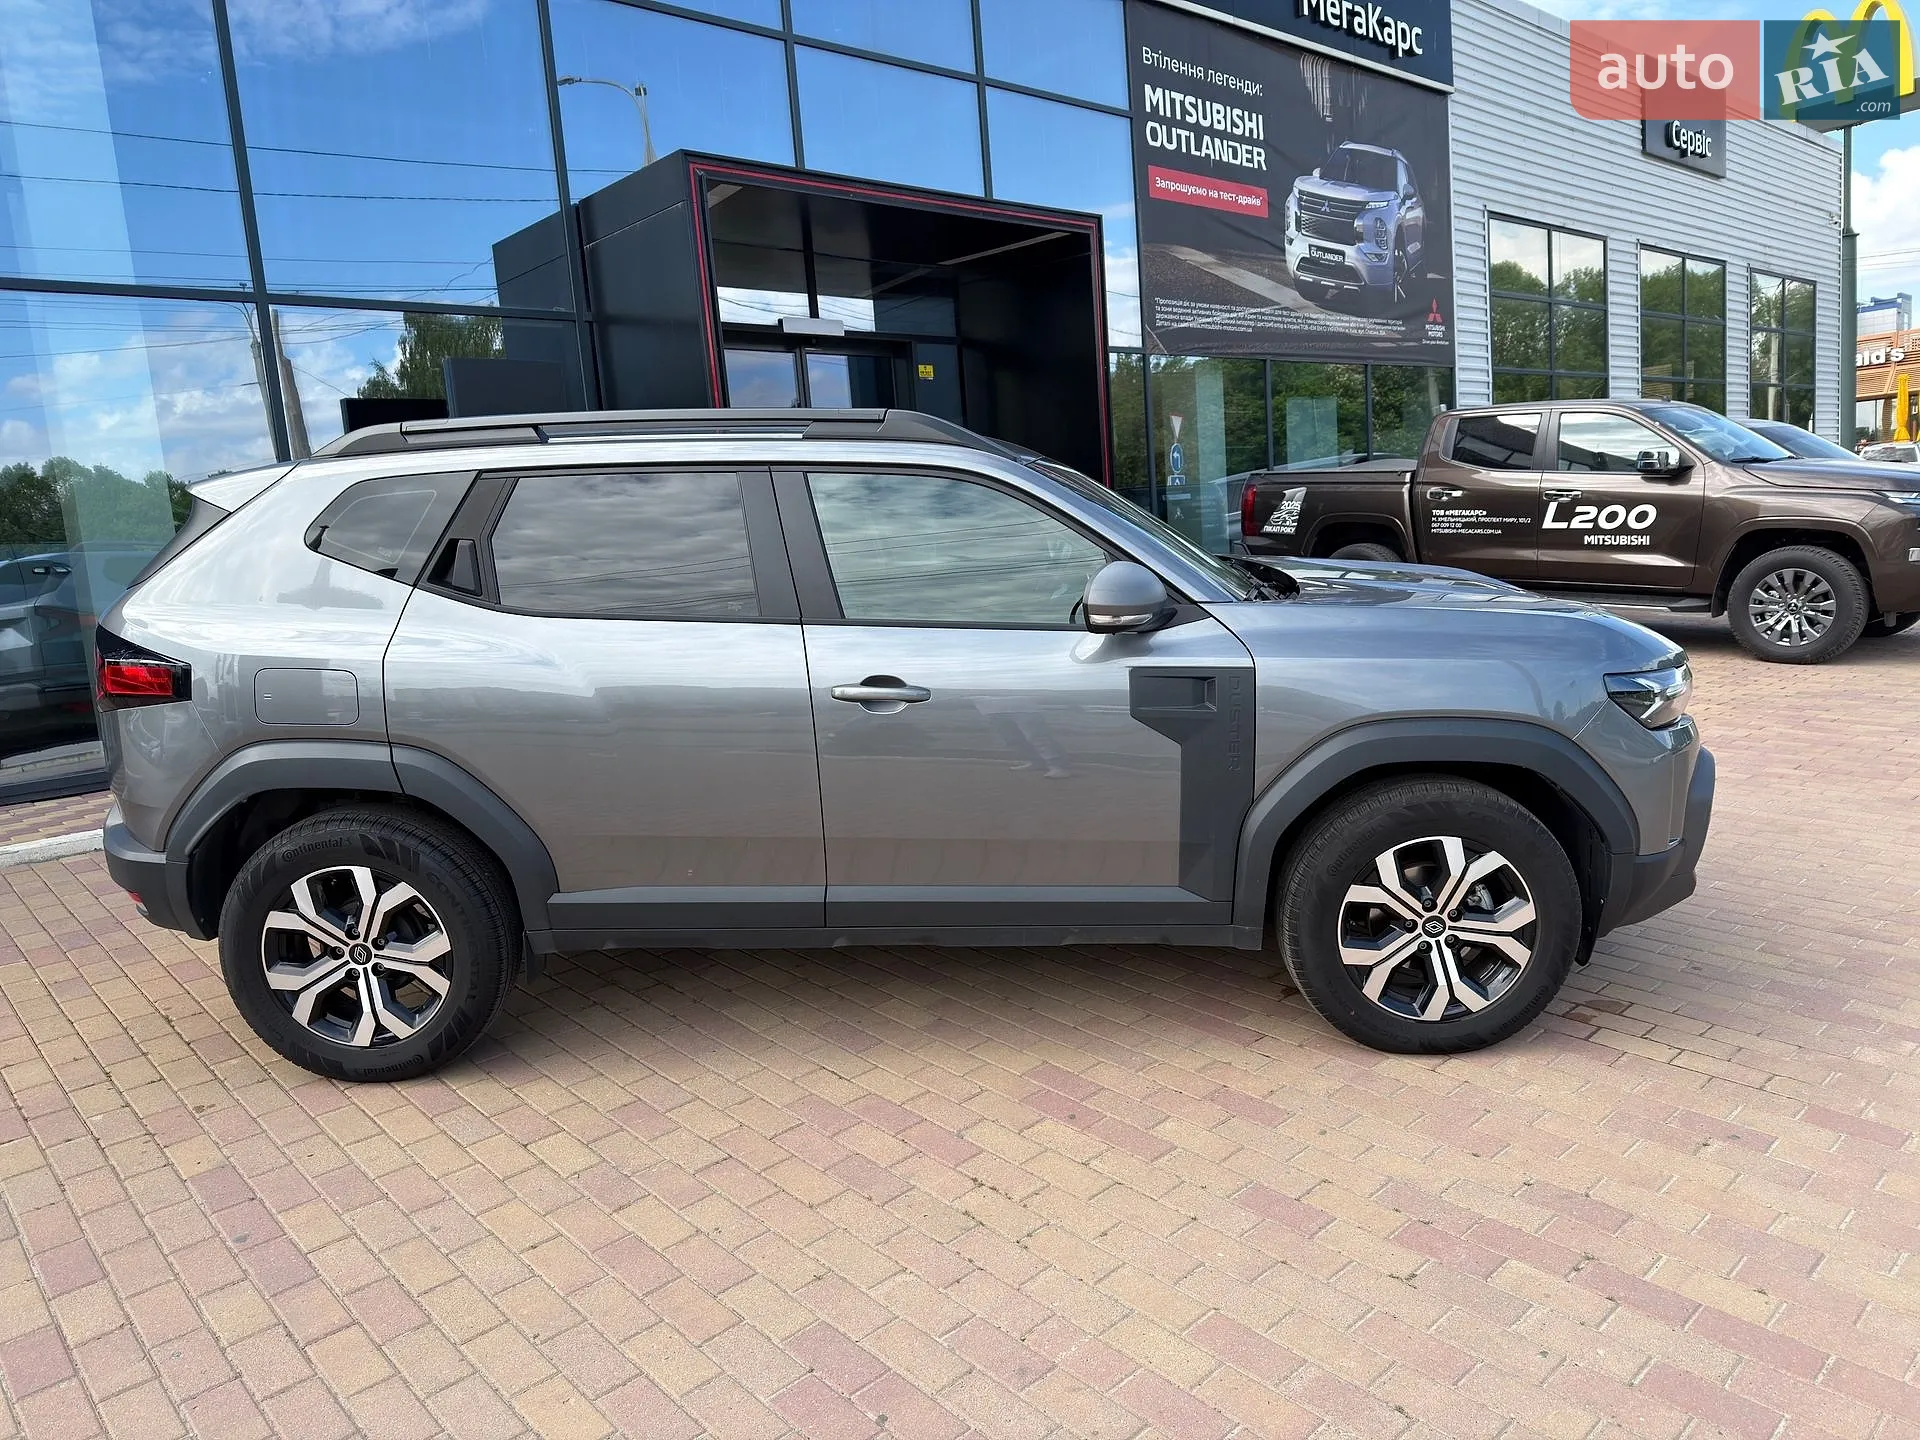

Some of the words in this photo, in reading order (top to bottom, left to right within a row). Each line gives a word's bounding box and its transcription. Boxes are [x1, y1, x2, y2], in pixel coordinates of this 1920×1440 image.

[1142, 46, 1204, 80] Втілення
[1208, 69, 1263, 97] легенди:
[1144, 83, 1265, 140] MITSUBISHI
[1145, 121, 1267, 171] OUTLANDER
[1672, 120, 1712, 157] Сервіс
[1156, 176, 1207, 196] Запрошуємо
[1209, 188, 1219, 199] на
[1281, 500, 1301, 511] 2025
[1541, 501, 1657, 530] L200
[1584, 534, 1650, 545] MITSUBISHI
[282, 837, 344, 863] Continental
